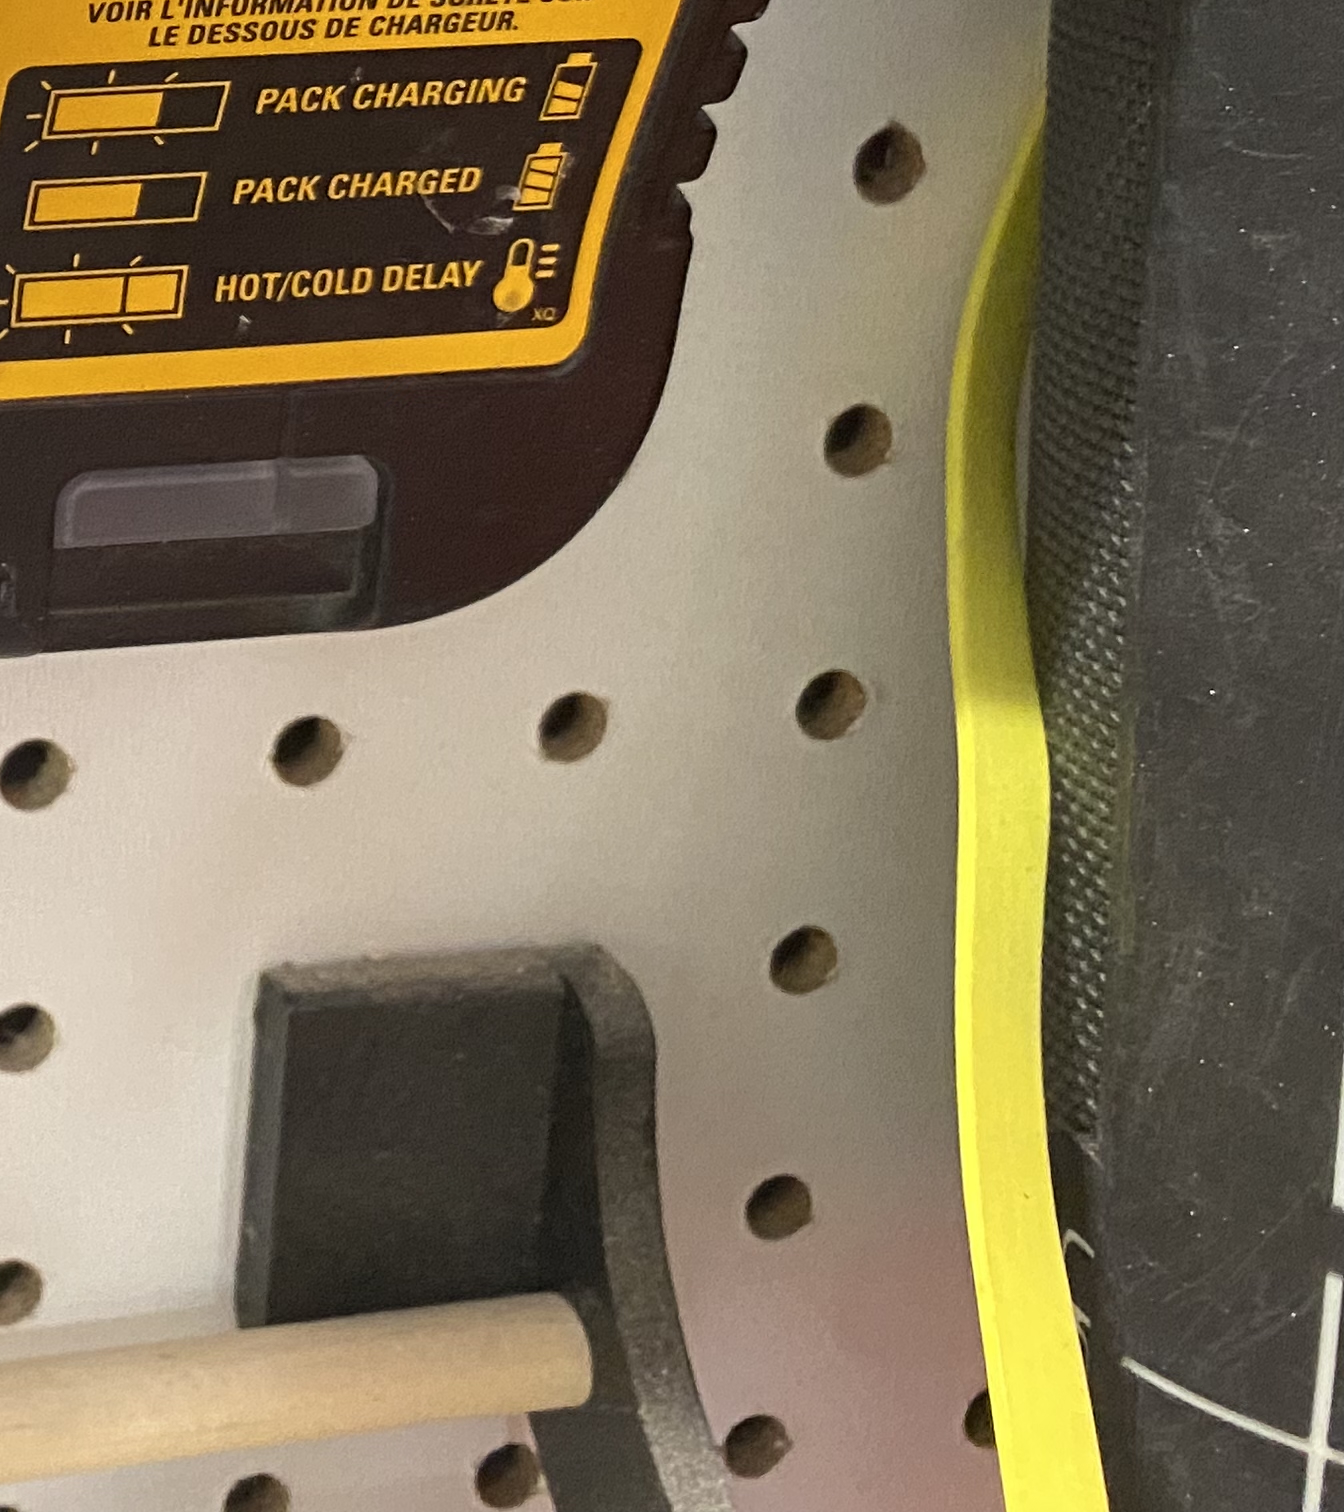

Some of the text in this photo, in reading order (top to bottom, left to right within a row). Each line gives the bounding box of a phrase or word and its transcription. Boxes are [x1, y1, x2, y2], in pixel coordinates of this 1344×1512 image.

[88, 0, 154, 23] VOIR
[149, 11, 520, 47] LE DESSOUS DE CHARGEUR.
[256, 77, 527, 114] PACK CHARGING
[232, 167, 483, 205] PACK CHARGED
[215, 261, 485, 303] HOT/COLD DELAY
